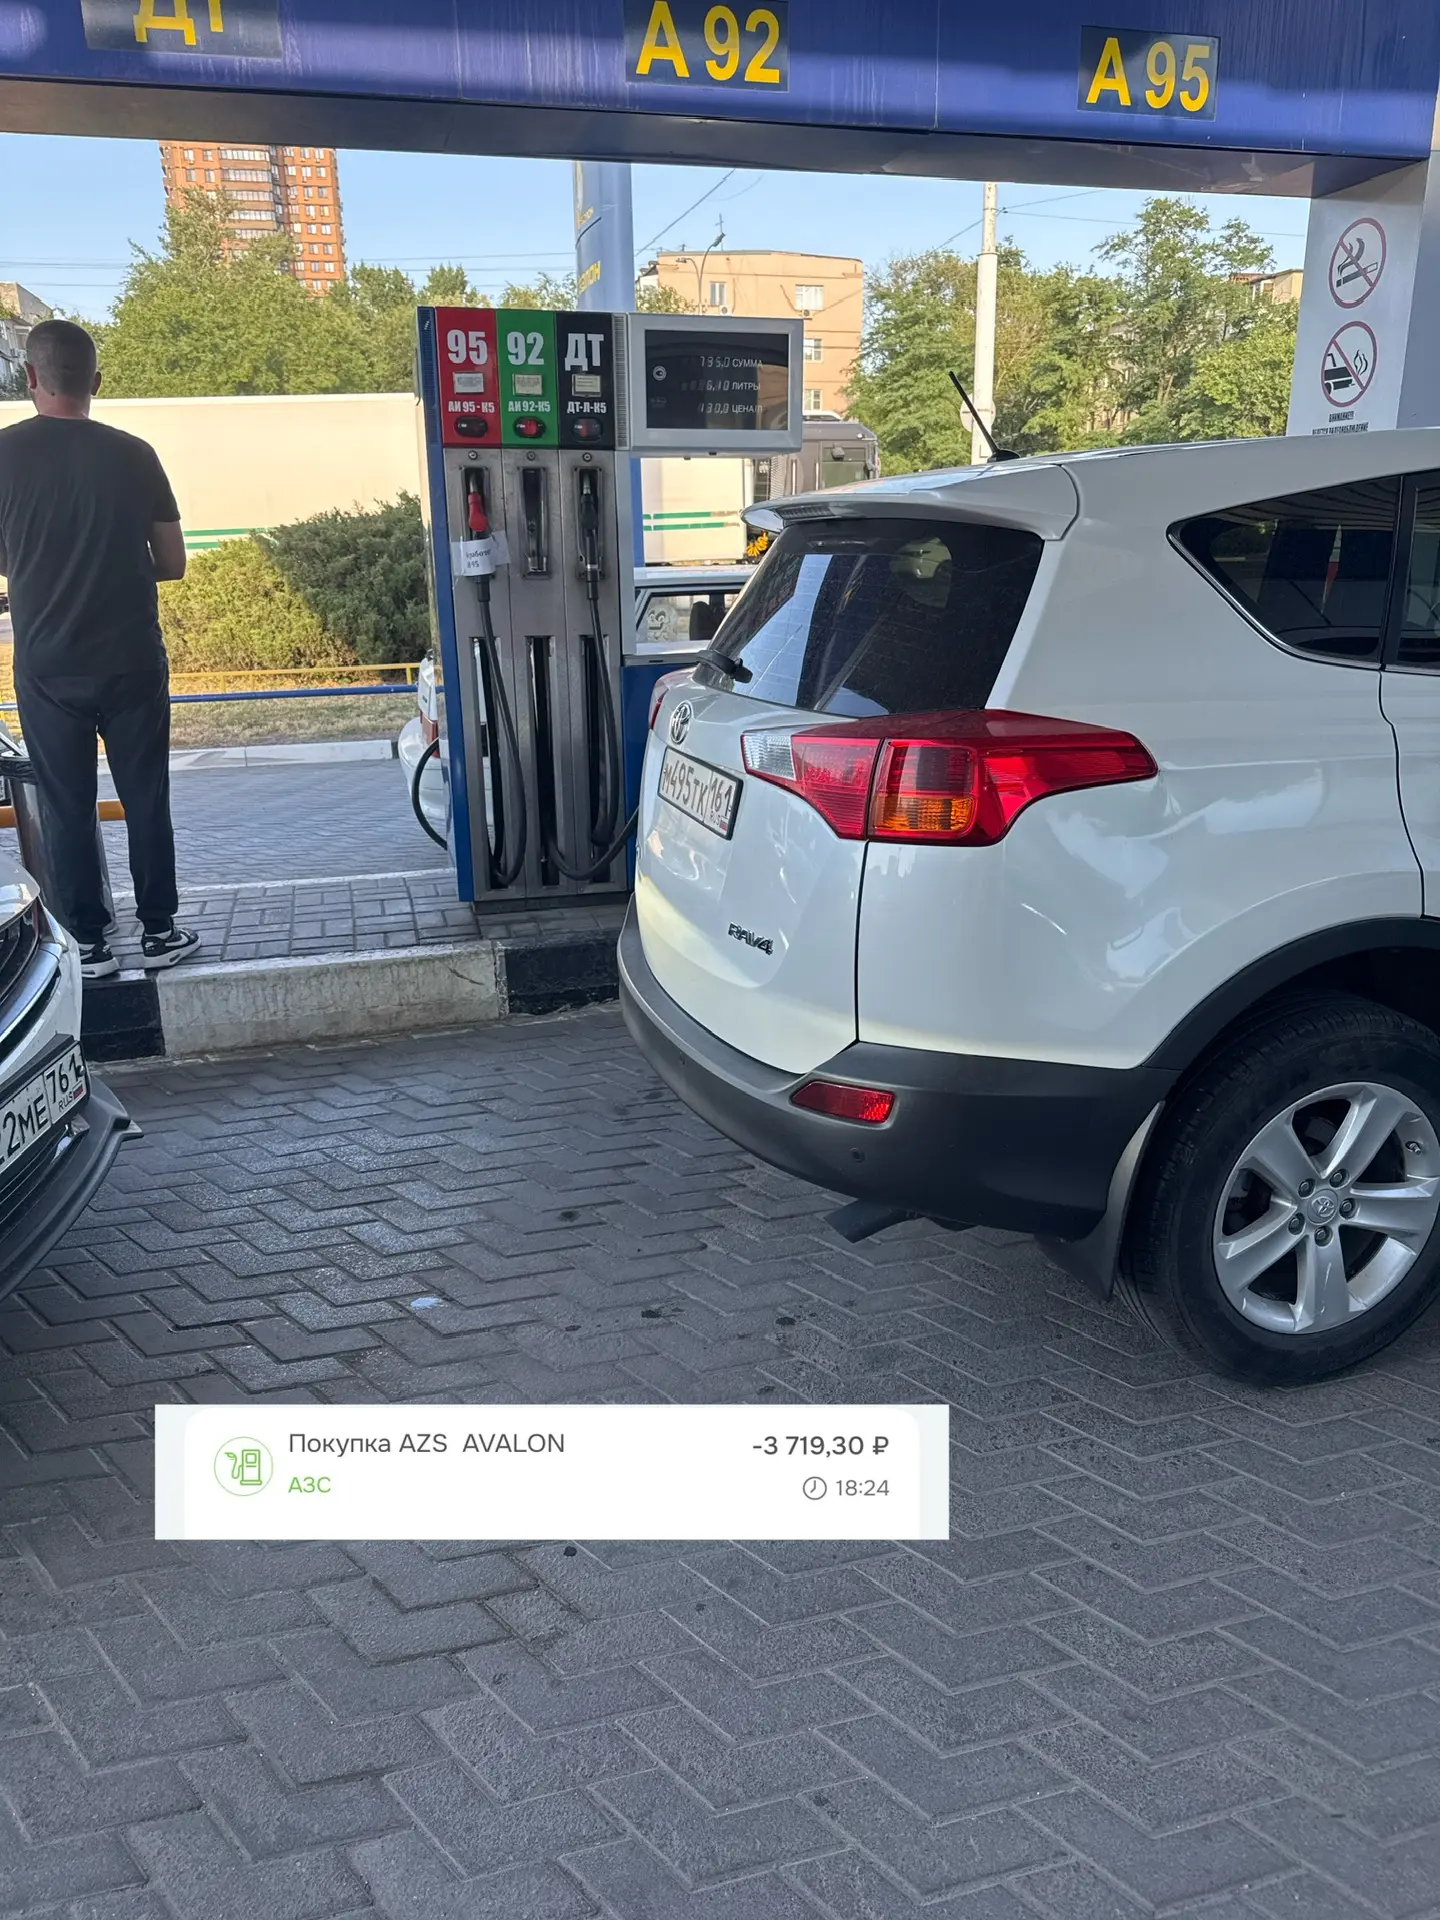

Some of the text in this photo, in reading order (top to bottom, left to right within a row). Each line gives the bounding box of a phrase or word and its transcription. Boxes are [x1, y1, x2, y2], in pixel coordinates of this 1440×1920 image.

[636, 1, 780, 83] А 92
[1086, 37, 1210, 112] А 95
[446, 329, 488, 366] 95
[506, 331, 545, 366] 92
[564, 333, 604, 372] ДТ
[732, 359, 763, 368] СУММА
[732, 382, 761, 391] ЛИТРЫ
[448, 402, 462, 412] АИ
[508, 401, 551, 413] АИ 92-К5
[567, 402, 607, 414] ДТ-Л-К5
[728, 922, 774, 955] RAV4
[0, 1052, 79, 1165] 2МЕ 761
[58, 1091, 74, 1113] RUS
